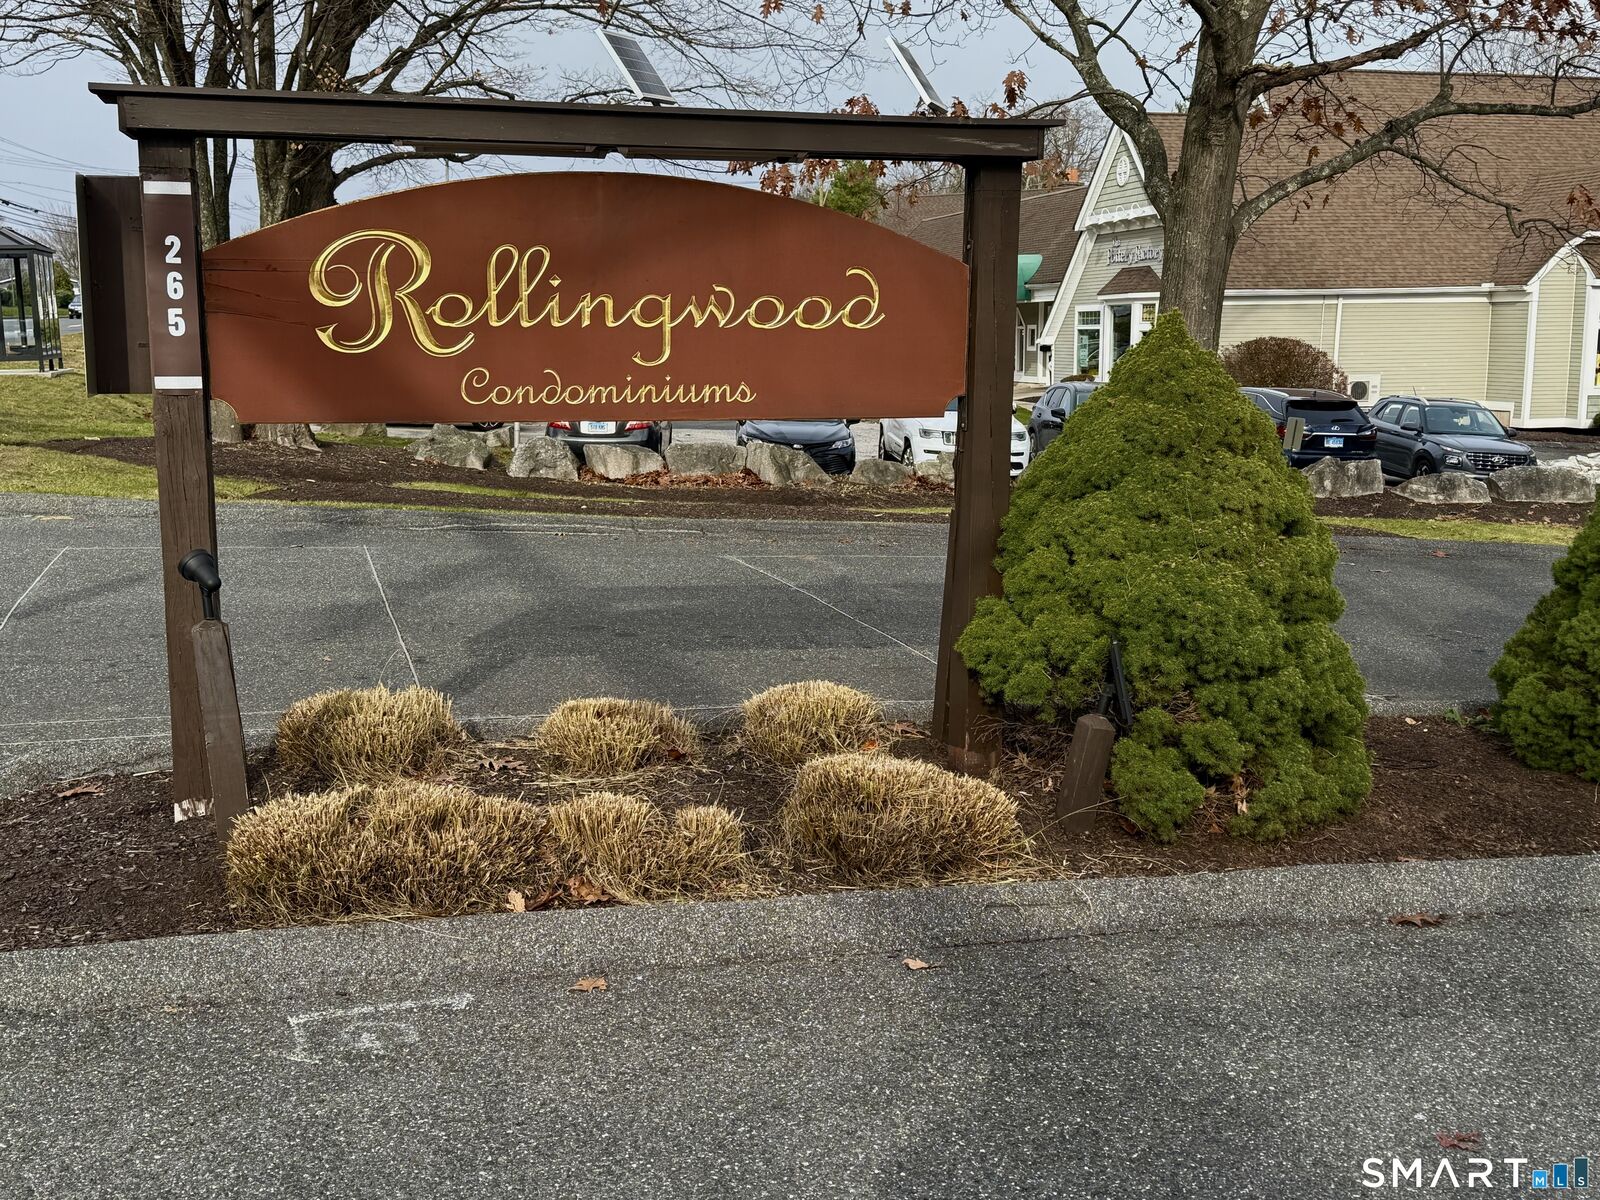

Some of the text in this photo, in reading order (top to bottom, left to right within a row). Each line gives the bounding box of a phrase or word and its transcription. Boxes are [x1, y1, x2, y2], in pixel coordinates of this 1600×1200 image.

[164, 235, 186, 337] 265
[308, 228, 885, 366] Rollingwood
[461, 367, 756, 405] Condominiums
